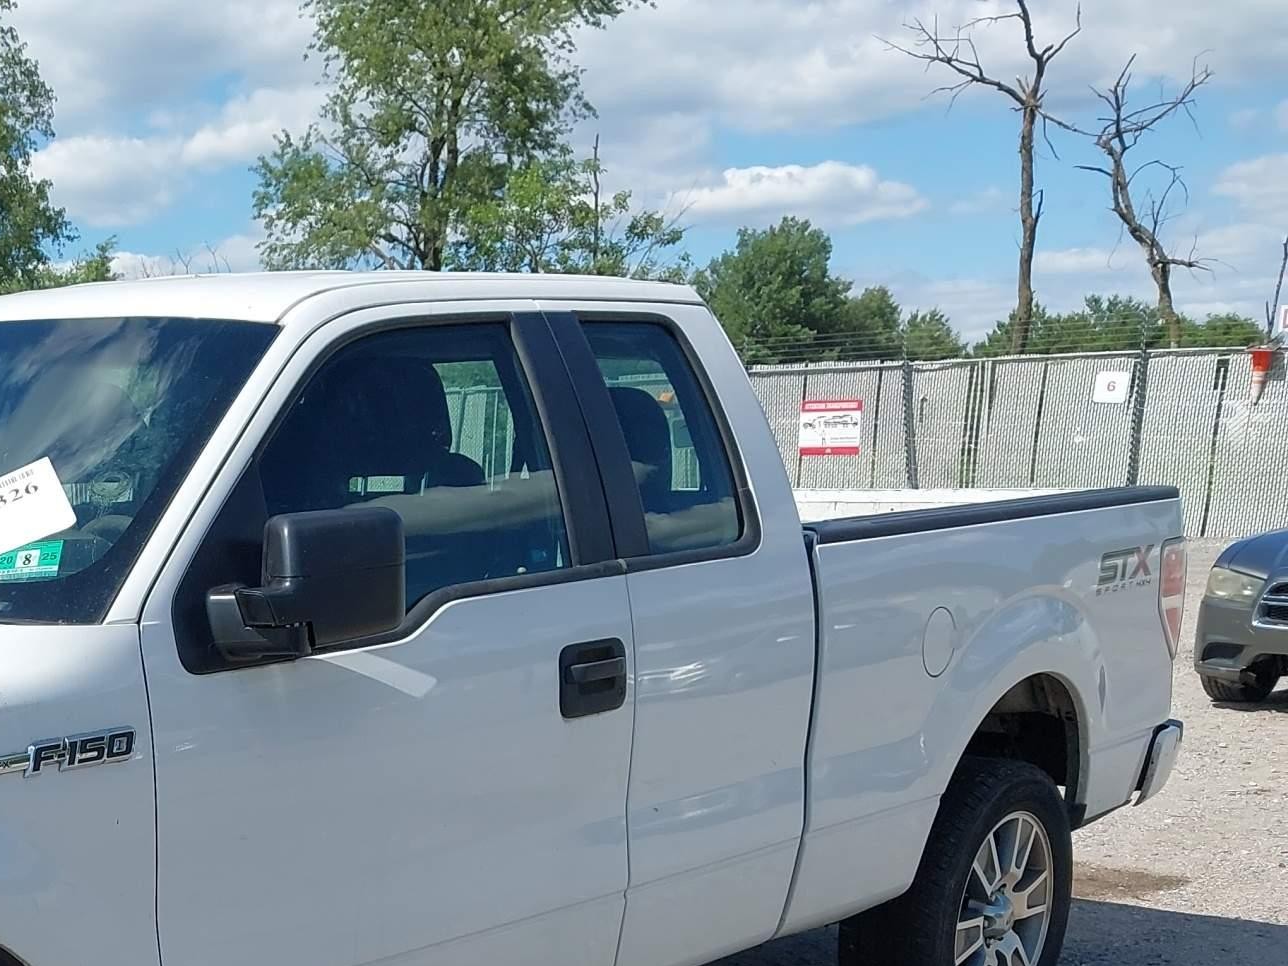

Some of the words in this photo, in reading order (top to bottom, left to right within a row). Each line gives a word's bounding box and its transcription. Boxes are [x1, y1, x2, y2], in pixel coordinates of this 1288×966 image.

[1107, 381, 1117, 392] 6
[0, 555, 14, 566] 20
[22, 553, 32, 566] 8
[41, 552, 57, 561] 25
[1097, 544, 1154, 586] STX
[31, 730, 136, 773] F-150
